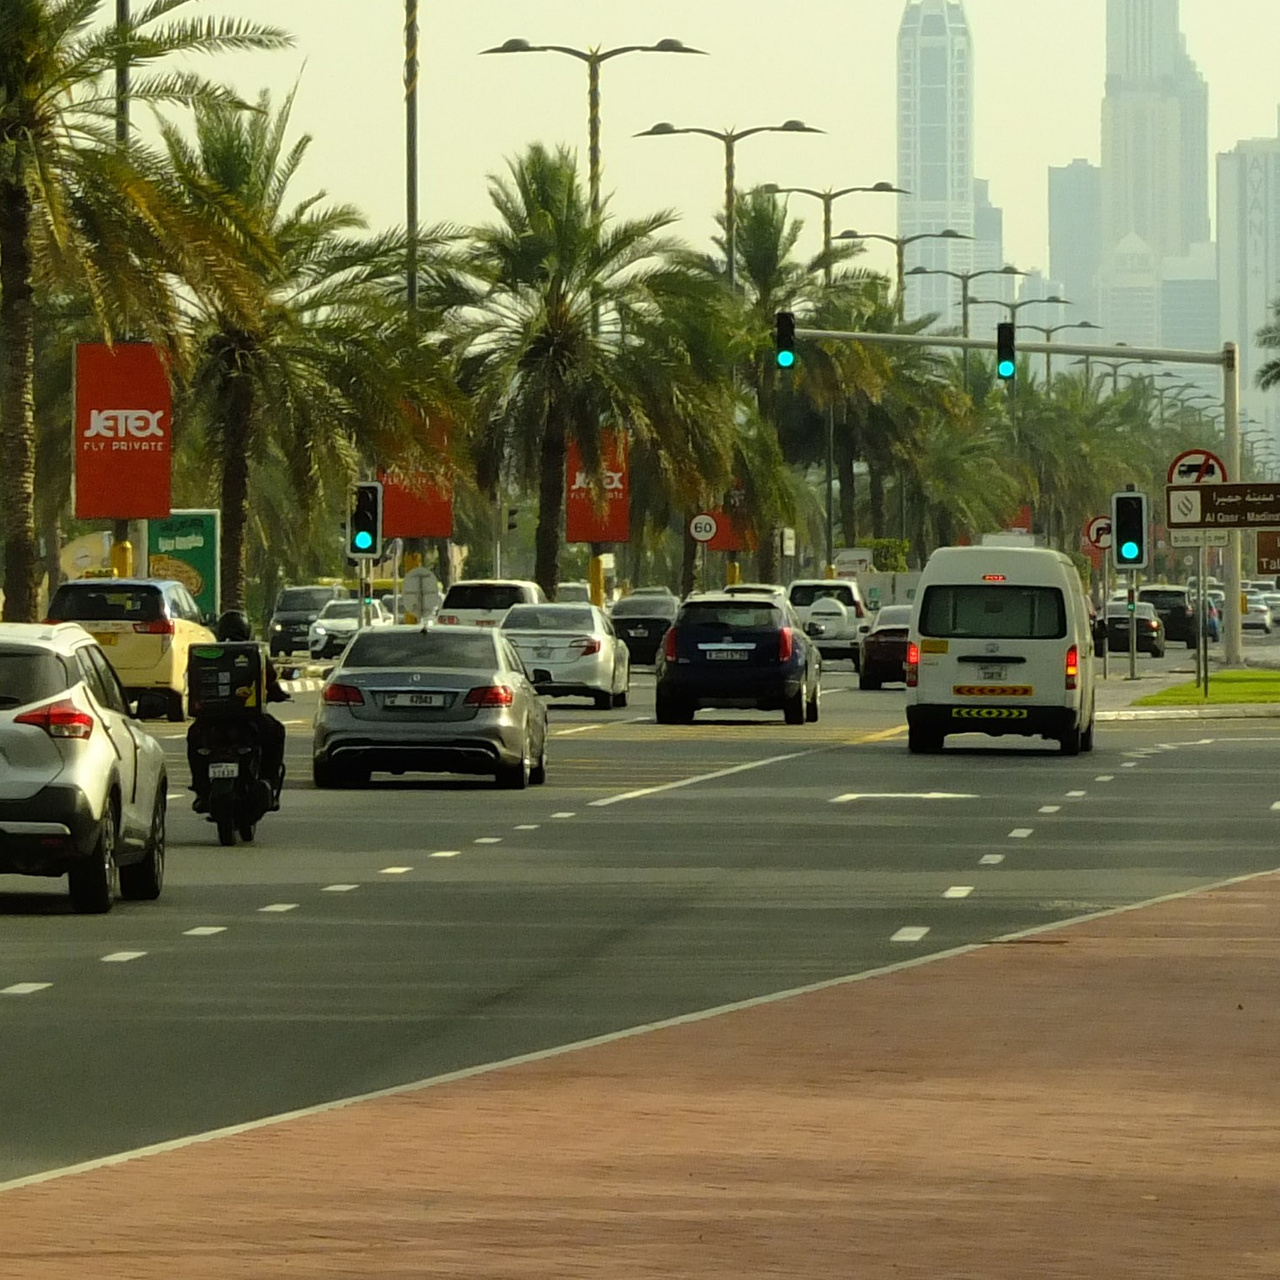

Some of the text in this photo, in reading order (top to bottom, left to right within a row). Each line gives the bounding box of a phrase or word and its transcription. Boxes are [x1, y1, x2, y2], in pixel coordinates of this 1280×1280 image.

[83, 409, 164, 438] JETEX
[83, 442, 164, 451] FLY PRIVATE
[571, 471, 623, 490] JEX
[694, 522, 712, 533] 60
